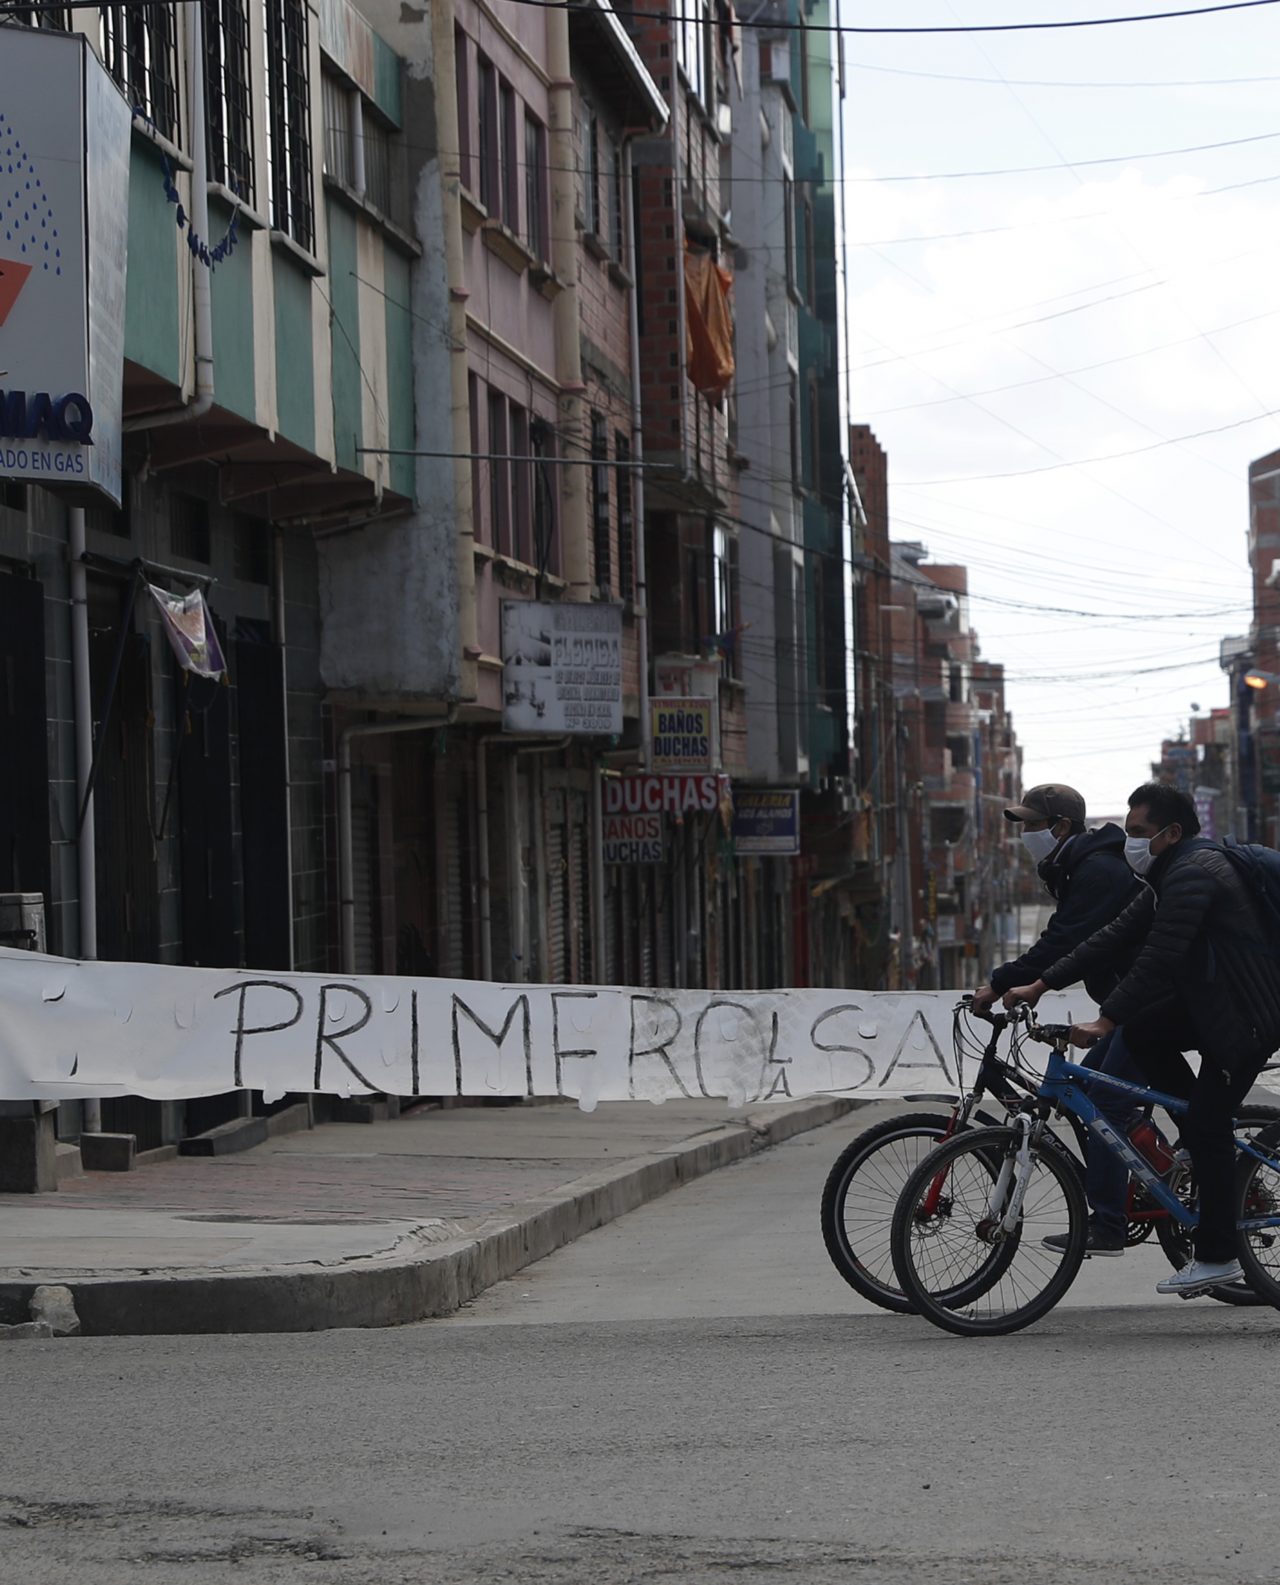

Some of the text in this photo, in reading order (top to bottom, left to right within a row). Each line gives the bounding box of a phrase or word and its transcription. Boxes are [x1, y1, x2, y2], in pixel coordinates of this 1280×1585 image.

[32, 452, 51, 471] EN
[54, 453, 84, 473] GAS
[658, 708, 704, 734] BAÑOS
[654, 736, 708, 757] DUCHAS
[606, 777, 718, 812] DUCHAS
[214, 980, 767, 1099] PRIMERO
